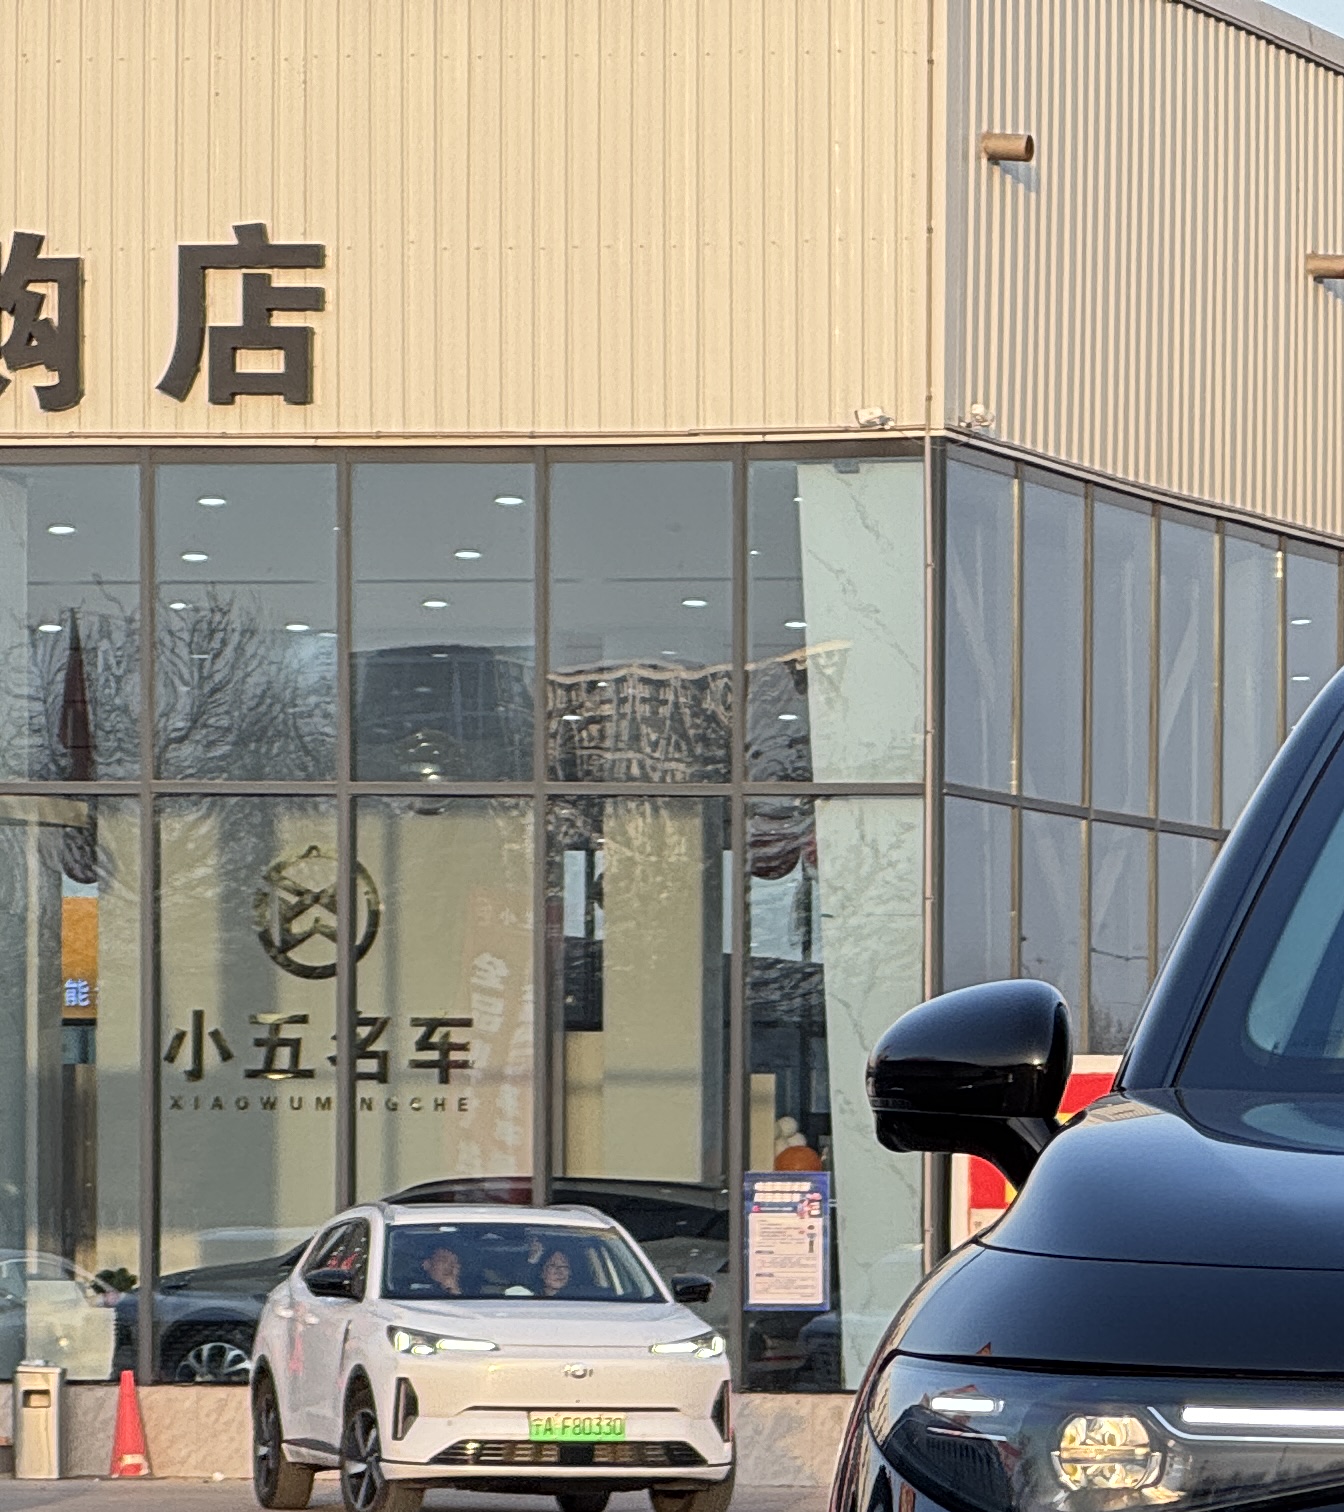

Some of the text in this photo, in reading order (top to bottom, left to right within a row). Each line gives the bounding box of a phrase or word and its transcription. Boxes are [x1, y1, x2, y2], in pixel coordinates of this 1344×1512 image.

[163, 1009, 474, 1084] 小五名车
[169, 1095, 470, 1112] XIAOWUMNGCHE
